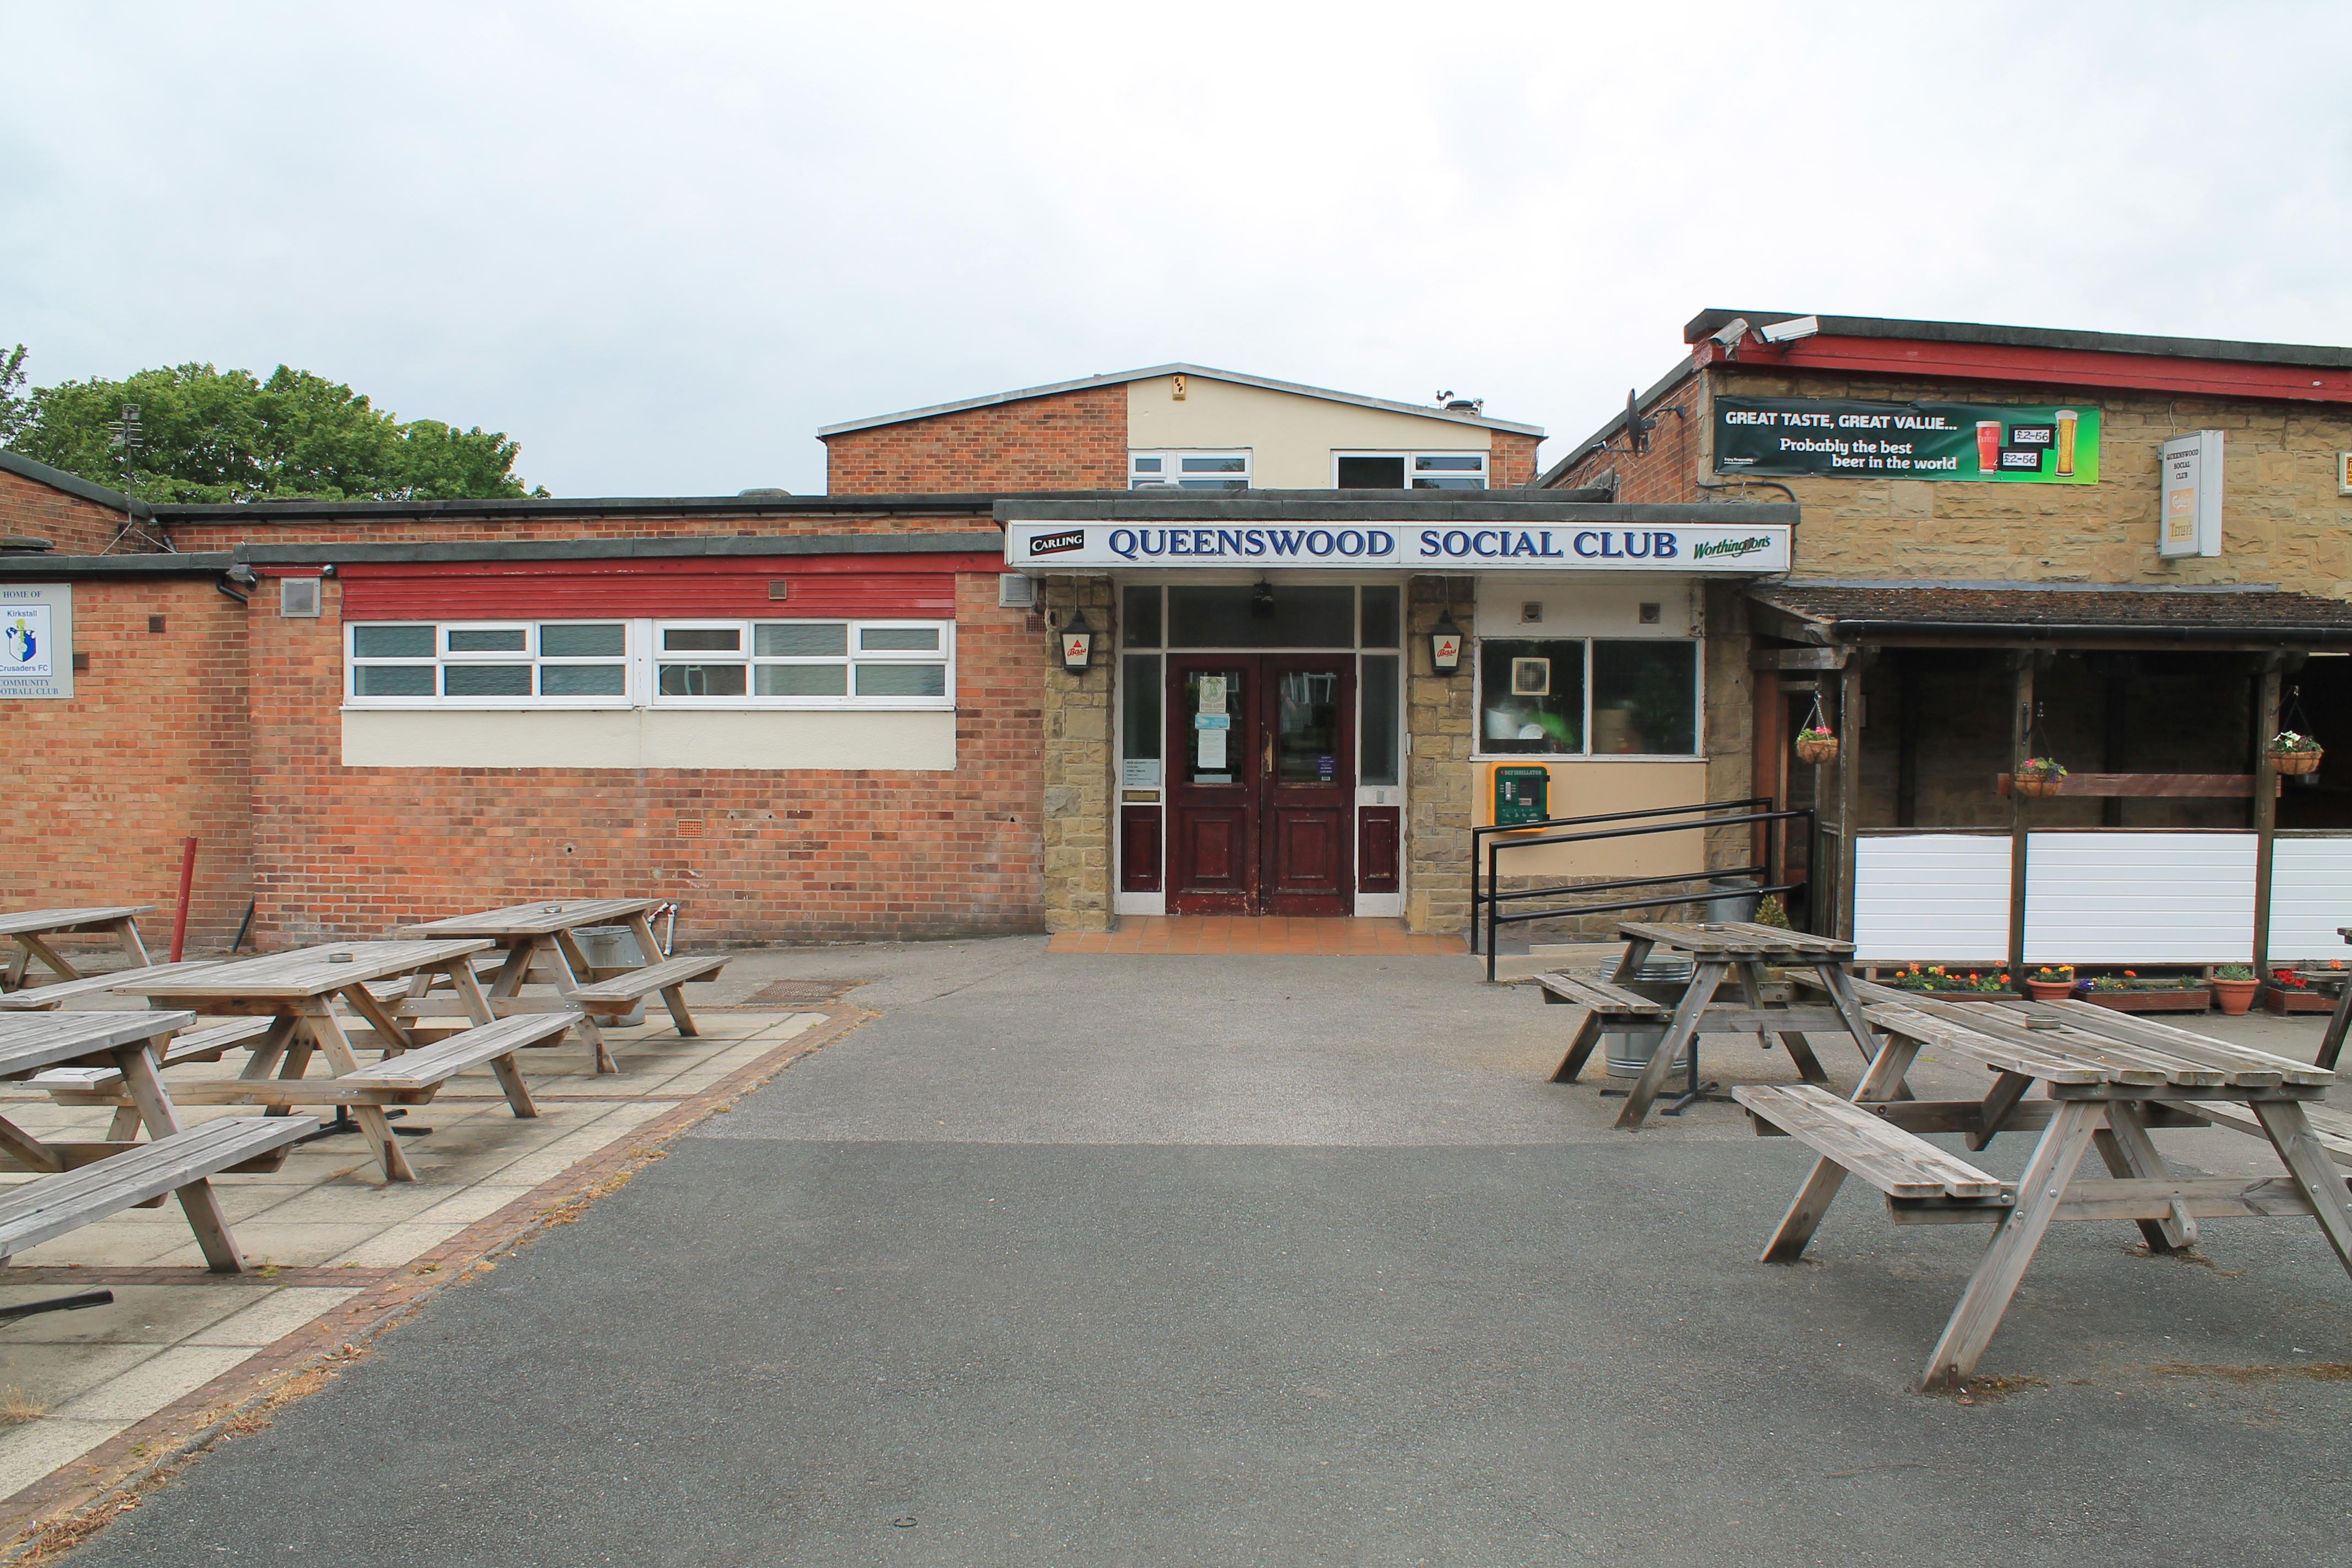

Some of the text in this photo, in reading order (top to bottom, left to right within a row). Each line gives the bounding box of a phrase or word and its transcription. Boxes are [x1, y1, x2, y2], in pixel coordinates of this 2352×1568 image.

[1725, 411, 1958, 431] GREAT TASTE, GREAT VALUE...
[2016, 431, 2049, 442] £2-56
[1779, 438, 1913, 455] Probably the best
[2003, 454, 2036, 464] £2-56
[2166, 449, 2199, 460] QUEENSWOOD
[1832, 454, 1958, 470] beer in the world
[2174, 461, 2191, 470] SOCIAL
[1031, 535, 1082, 552] CARLING
[1109, 529, 1678, 560] QUEENSWOOD SOCIAL CLUB
[1694, 535, 1771, 559] Worthington's
[1067, 647, 1086, 657] Bass
[1437, 649, 1457, 658] Bass
